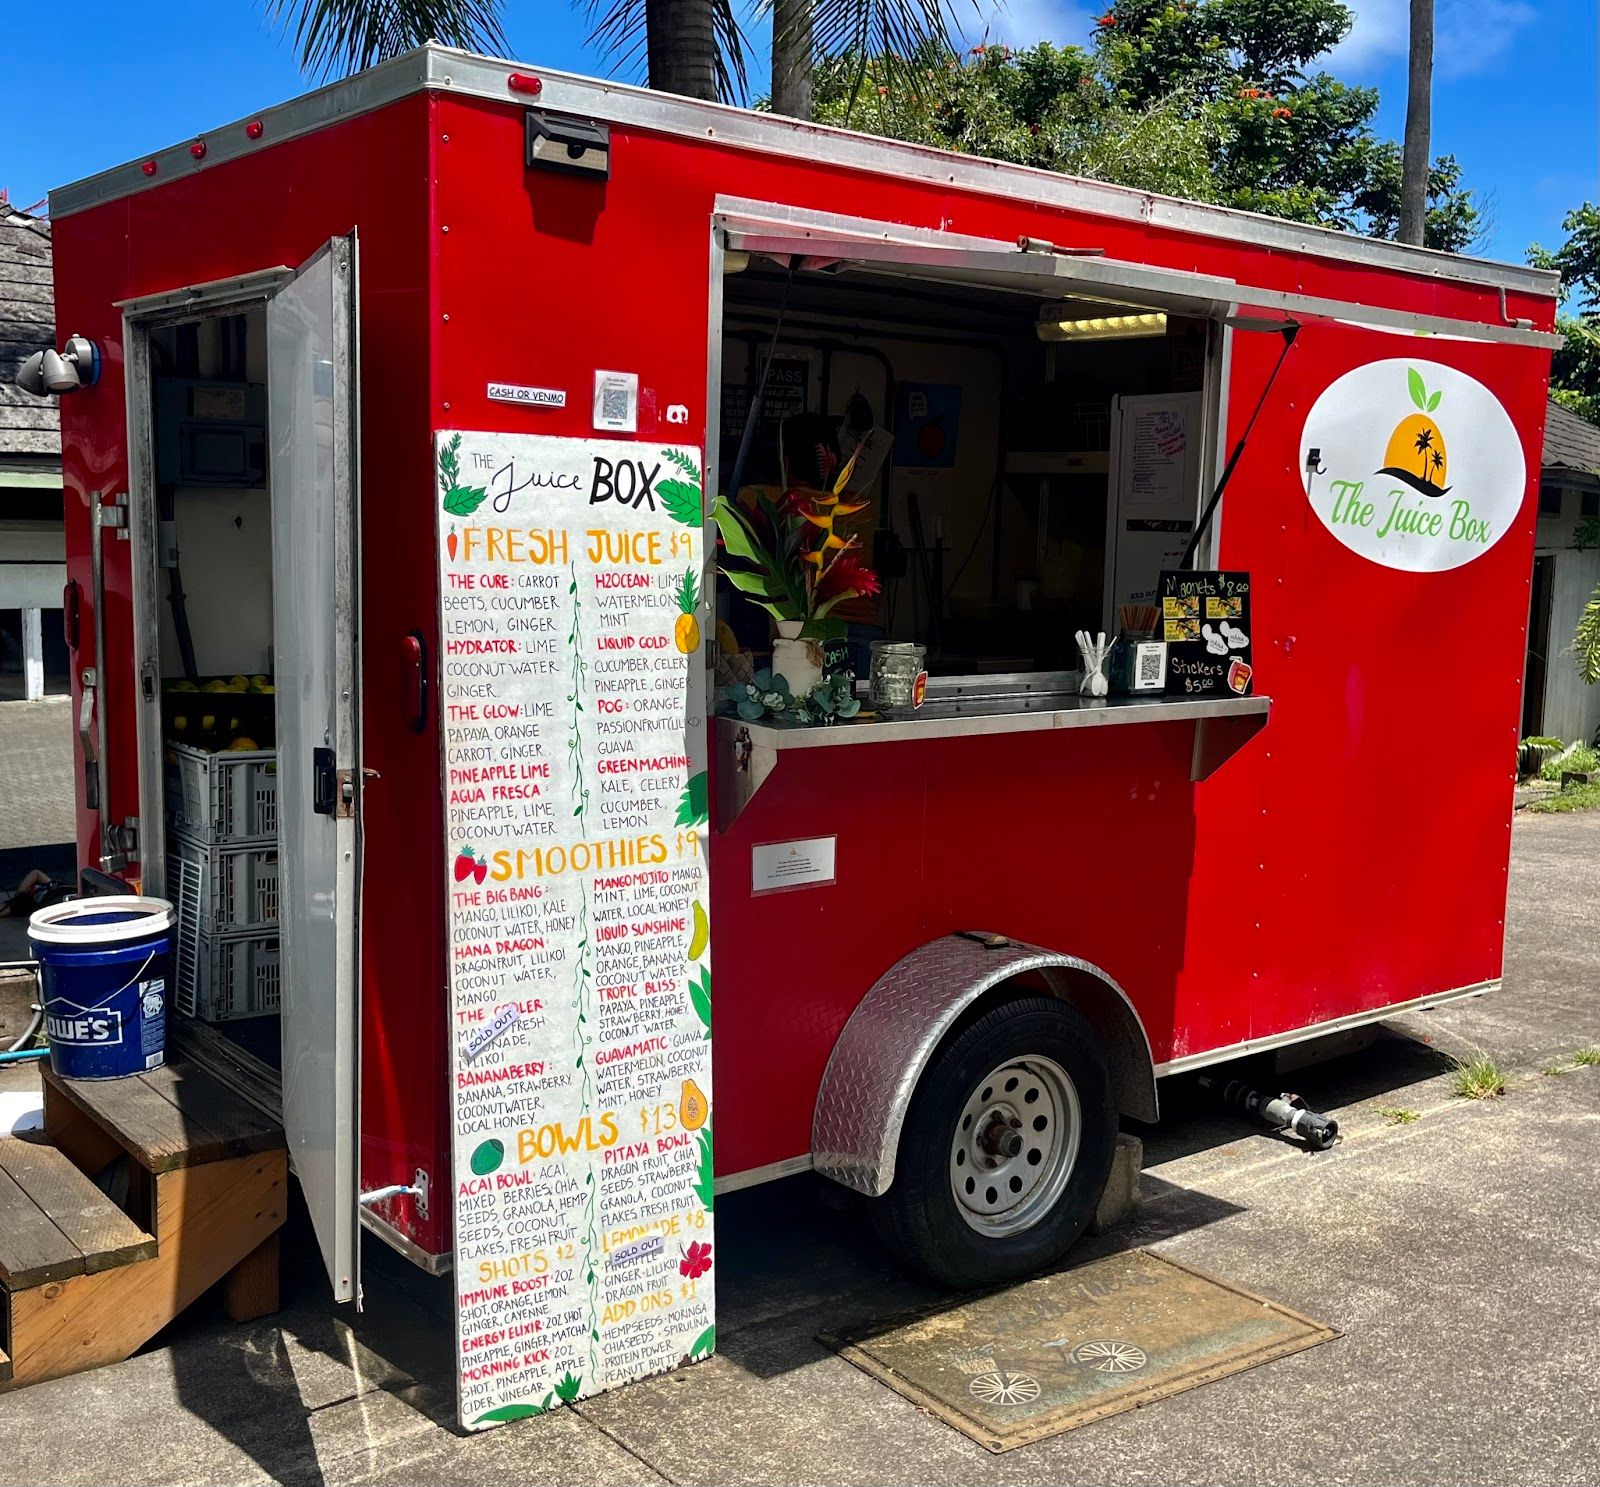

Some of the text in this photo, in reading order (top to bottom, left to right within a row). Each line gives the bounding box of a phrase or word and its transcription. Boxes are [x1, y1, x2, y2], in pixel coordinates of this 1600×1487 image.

[489, 386, 564, 404] CASH OR VENMO
[473, 453, 493, 469] THE
[589, 456, 661, 512] BOX
[1330, 480, 1491, 543] The Juice Box
[464, 528, 692, 564] FRESH JUICE $9
[448, 574, 474, 589] THE
[518, 575, 559, 589] CARROT
[658, 573, 685, 589] LIME
[492, 596, 560, 611] CUCUMBER
[448, 617, 556, 634] LEMON, GINGER
[526, 640, 557, 653] LIME
[597, 636, 634, 650] LIQUID
[824, 648, 849, 668] CASH
[1171, 657, 1223, 676] Stickers
[447, 661, 560, 677] COCONUT WATER
[448, 705, 479, 721] THE
[524, 702, 554, 718] LIME
[495, 724, 539, 738] ORANGE
[598, 740, 633, 755] GUAVA
[450, 763, 549, 785] PINEAPPLE LIME
[450, 789, 484, 804] AGUA
[601, 779, 632, 794] KALE,
[450, 802, 555, 823] PINEAPPLE, LIME,
[603, 815, 648, 829] LEMON
[490, 830, 698, 882] SMOOTHIES $9
[454, 889, 507, 908] THE BIG
[634, 882, 698, 900] LIME, COCONUT
[454, 908, 498, 925] MANGO,
[543, 899, 566, 914] KALE
[628, 903, 657, 917] LOCAL
[659, 899, 689, 914] HONEY
[454, 926, 500, 943] COCONUT
[546, 916, 575, 932] HONEY
[597, 925, 628, 942] LIQUID
[454, 943, 492, 960] HANA
[596, 935, 687, 959] MANGO, PINEAPPLE,
[597, 951, 686, 975] ORANGE, BANANA,
[456, 968, 556, 993] COCONUT WATER,
[596, 964, 686, 986] COCONUT WATER
[457, 989, 497, 1007] MANGO
[597, 984, 637, 1001] TROPIC
[640, 993, 686, 1009] PINEAPPLE
[457, 1008, 485, 1025] THE
[470, 1010, 512, 1051] SOLD OUT
[599, 1019, 677, 1043] COCONUT WATER
[672, 1031, 702, 1048] GUAVA
[667, 1044, 708, 1062] COCONUT
[629, 1085, 662, 1101] HONEY
[458, 1121, 491, 1136] LOCAL
[517, 1103, 676, 1165] BOWLS $13
[604, 1142, 649, 1165] PITAYA
[601, 1147, 695, 1181] DRAGON FRUIT, CHIA
[459, 1178, 492, 1198] ACAI
[459, 1178, 578, 1212] MIXED CHIA
[652, 1178, 694, 1198] COCONUT
[459, 1192, 587, 1228] SEEDS, GRANOLA, HEMP
[641, 1194, 695, 1218] FRESH FRUIT
[459, 1224, 503, 1244] SEEDS,
[615, 1237, 660, 1261] SOLD OUT
[479, 1243, 575, 1283] SHOTS $2
[647, 1276, 668, 1293] FRUIT
[460, 1287, 508, 1307] IMMUNE
[505, 1305, 549, 1324] CAYENNE
[602, 1300, 636, 1326] ADD
[640, 1289, 673, 1316] ONS
[668, 1303, 708, 1322] MORINGA
[462, 1307, 583, 1353] ENERGY SHOT
[462, 1347, 514, 1369] PINEAPPLE,
[640, 1340, 673, 1359] POWER
[462, 1358, 521, 1383] MORNING
[496, 1356, 585, 1389] PINEAPPLE, APPLE
[462, 1382, 546, 1415] CIDER VINEGAR
